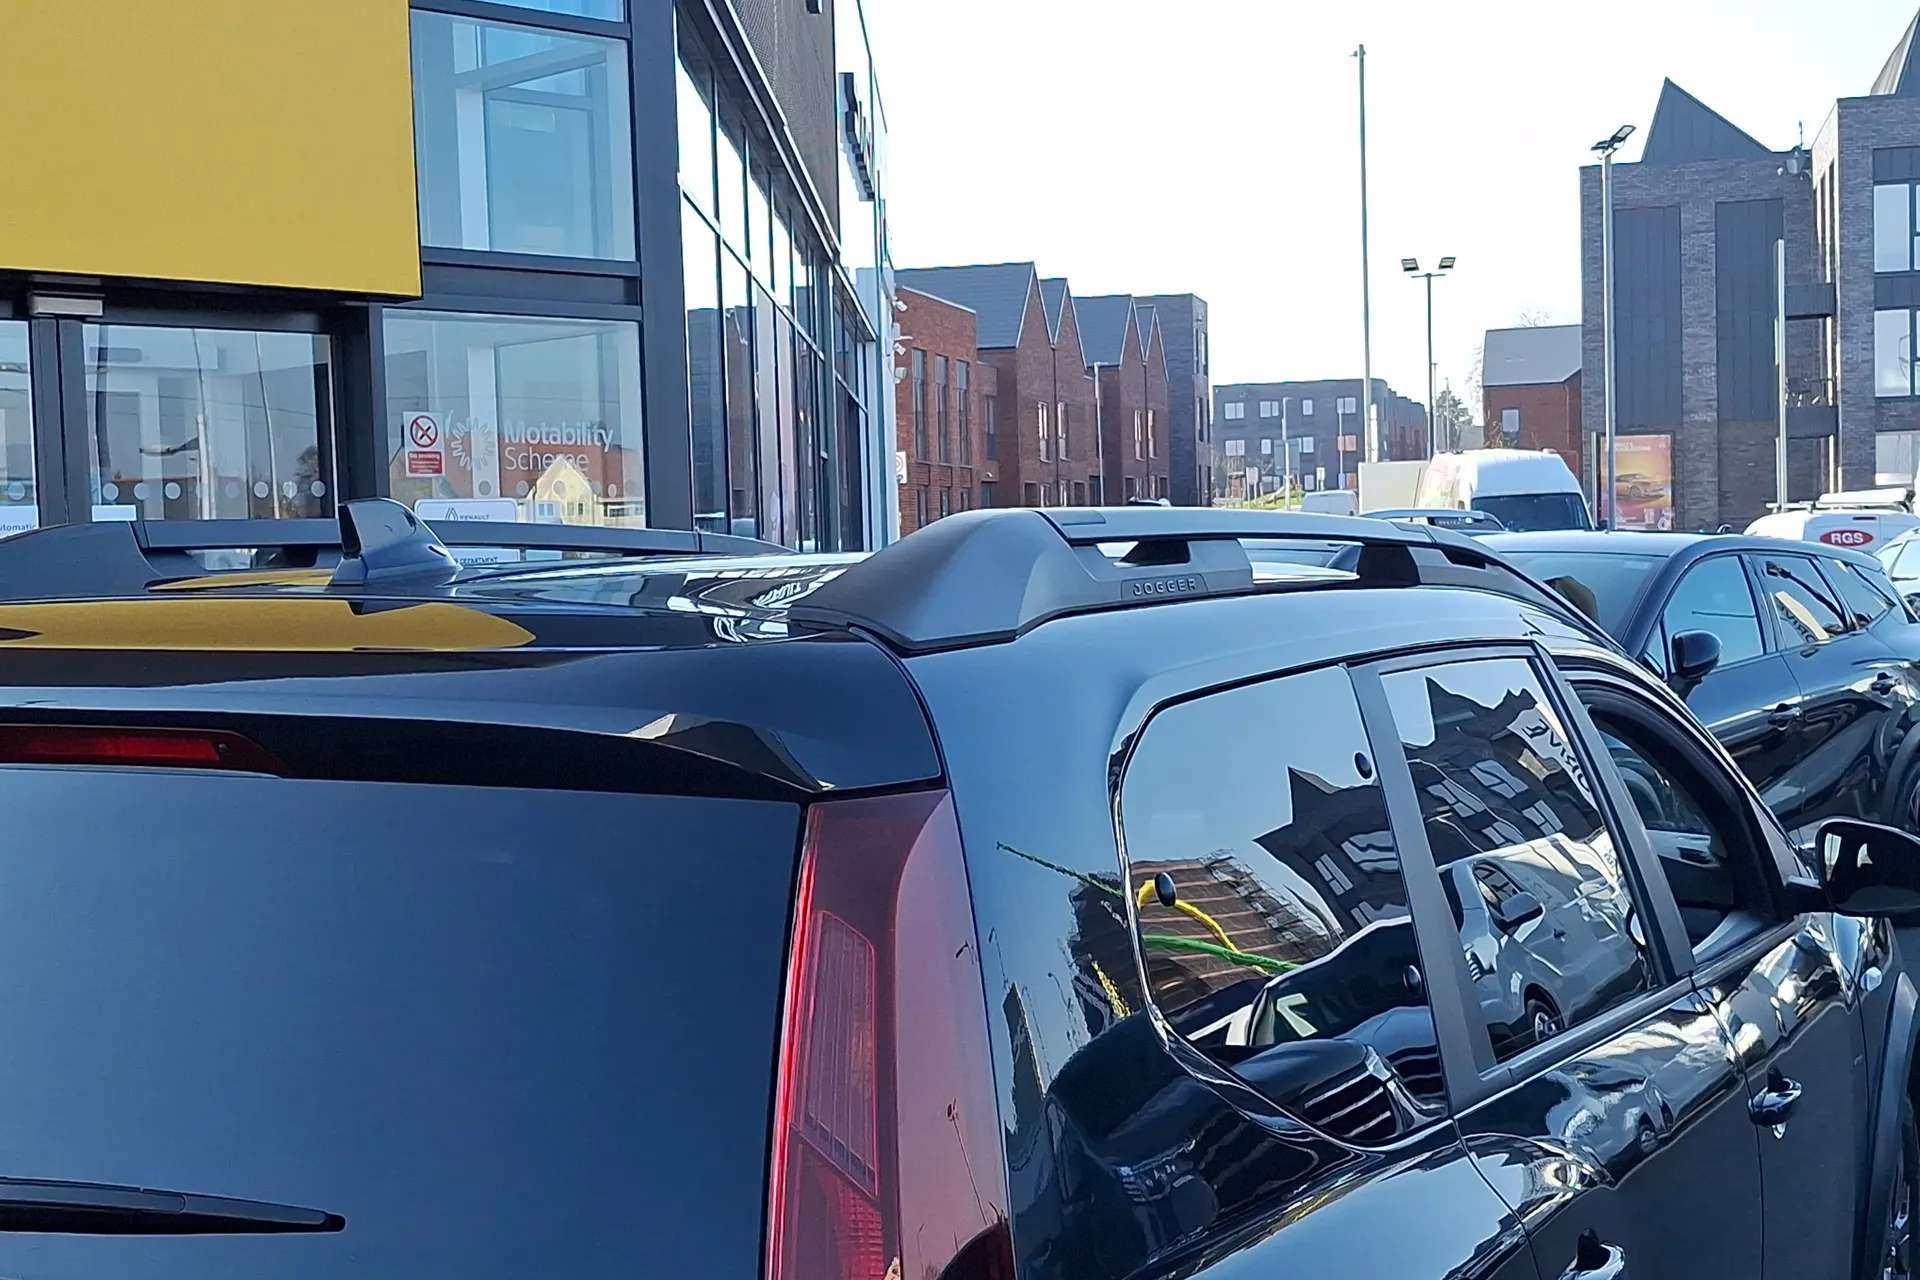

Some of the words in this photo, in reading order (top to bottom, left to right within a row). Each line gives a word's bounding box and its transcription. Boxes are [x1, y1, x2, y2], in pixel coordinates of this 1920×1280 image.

[505, 419, 614, 453] Motability
[1831, 532, 1864, 544] RGS
[1132, 578, 1196, 596] JOGGER
